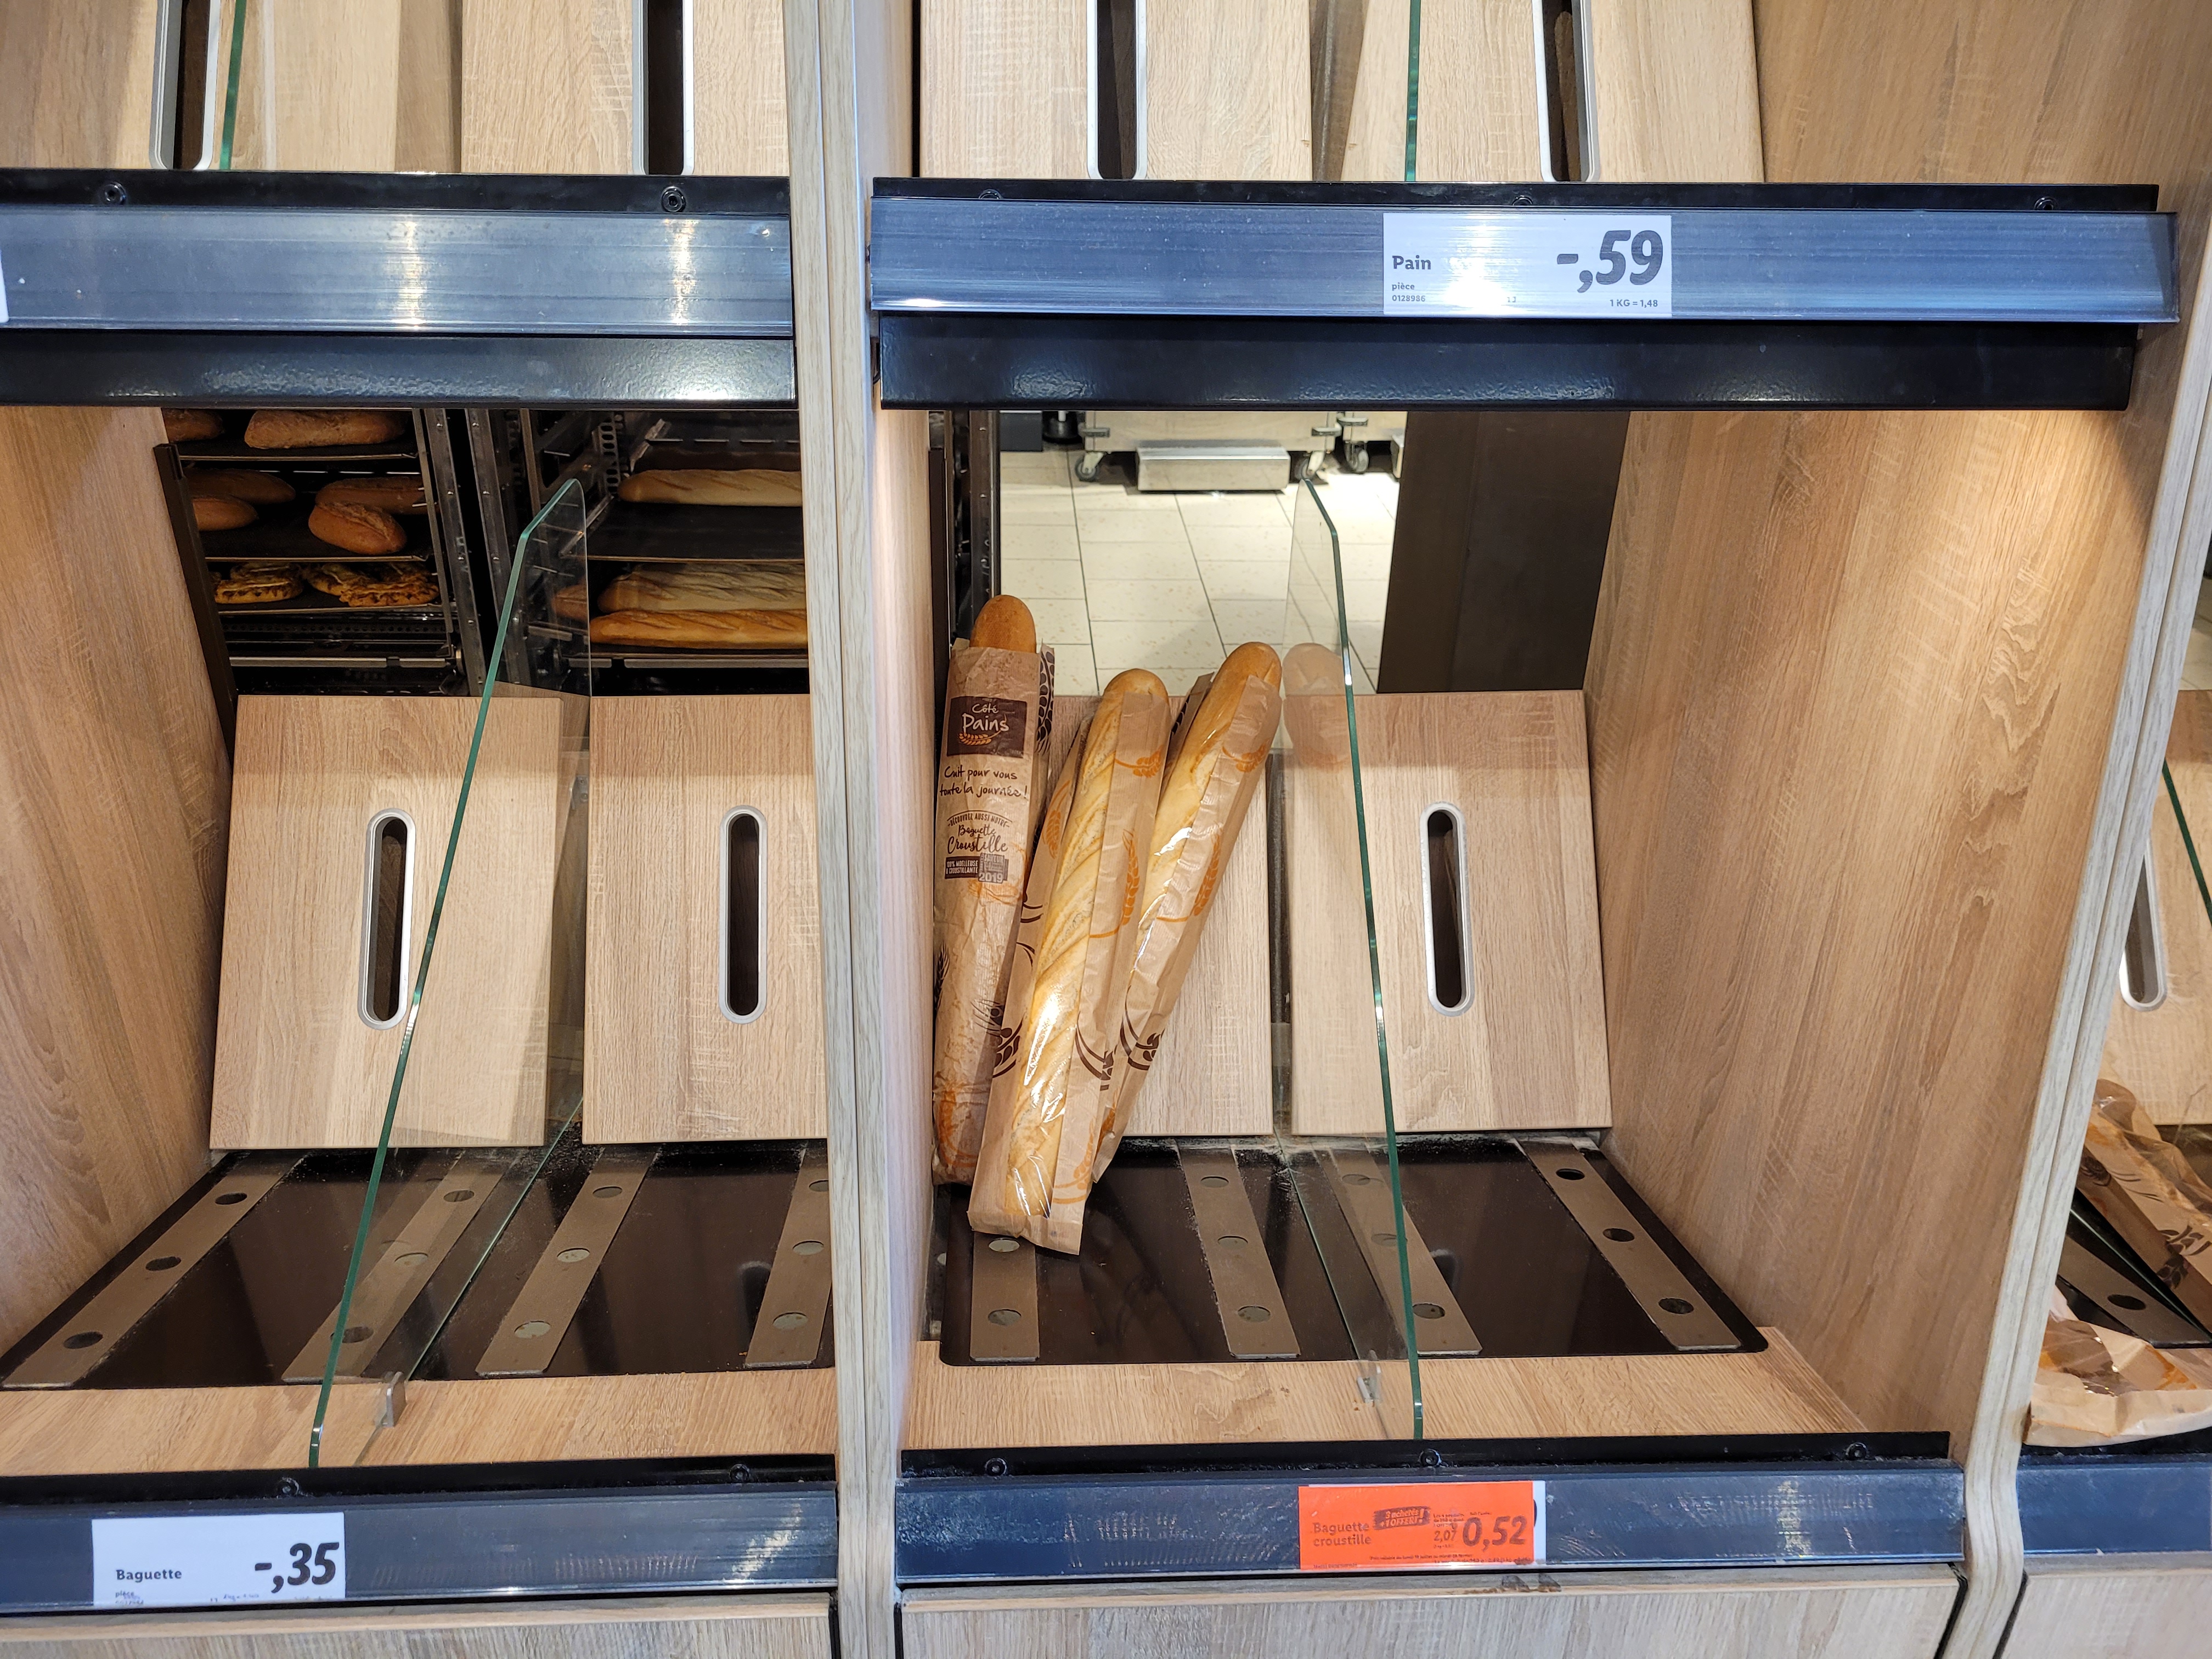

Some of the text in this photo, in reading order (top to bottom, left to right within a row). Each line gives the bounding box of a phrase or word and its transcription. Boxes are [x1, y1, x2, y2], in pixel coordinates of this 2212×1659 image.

[1392, 255, 1431, 270] Pain
[1392, 282, 1415, 291] pièce
[1640, 300, 1658, 308] 1,48
[972, 703, 999, 713] Côté
[962, 713, 1009, 733] Pains
[944, 765, 1018, 781] Cuit pour vous
[940, 782, 962, 796] toute
[964, 782, 973, 794] la
[976, 784, 1022, 798] journée
[974, 812, 990, 821] AUSSI
[991, 815, 1007, 827] NOTRE
[958, 824, 997, 837] Baguette
[947, 834, 1008, 854] Croustille
[979, 872, 1003, 883] 2019
[1391, 1508, 1419, 1518] achetés
[1312, 1522, 1369, 1536] Baguette
[1463, 1515, 1527, 1552] 0,52
[1313, 1534, 1372, 1547] croustille
[1434, 1530, 1458, 1543] 2,07
[255, 1542, 340, 1593] -,35
[116, 1569, 182, 1583] Baguette
